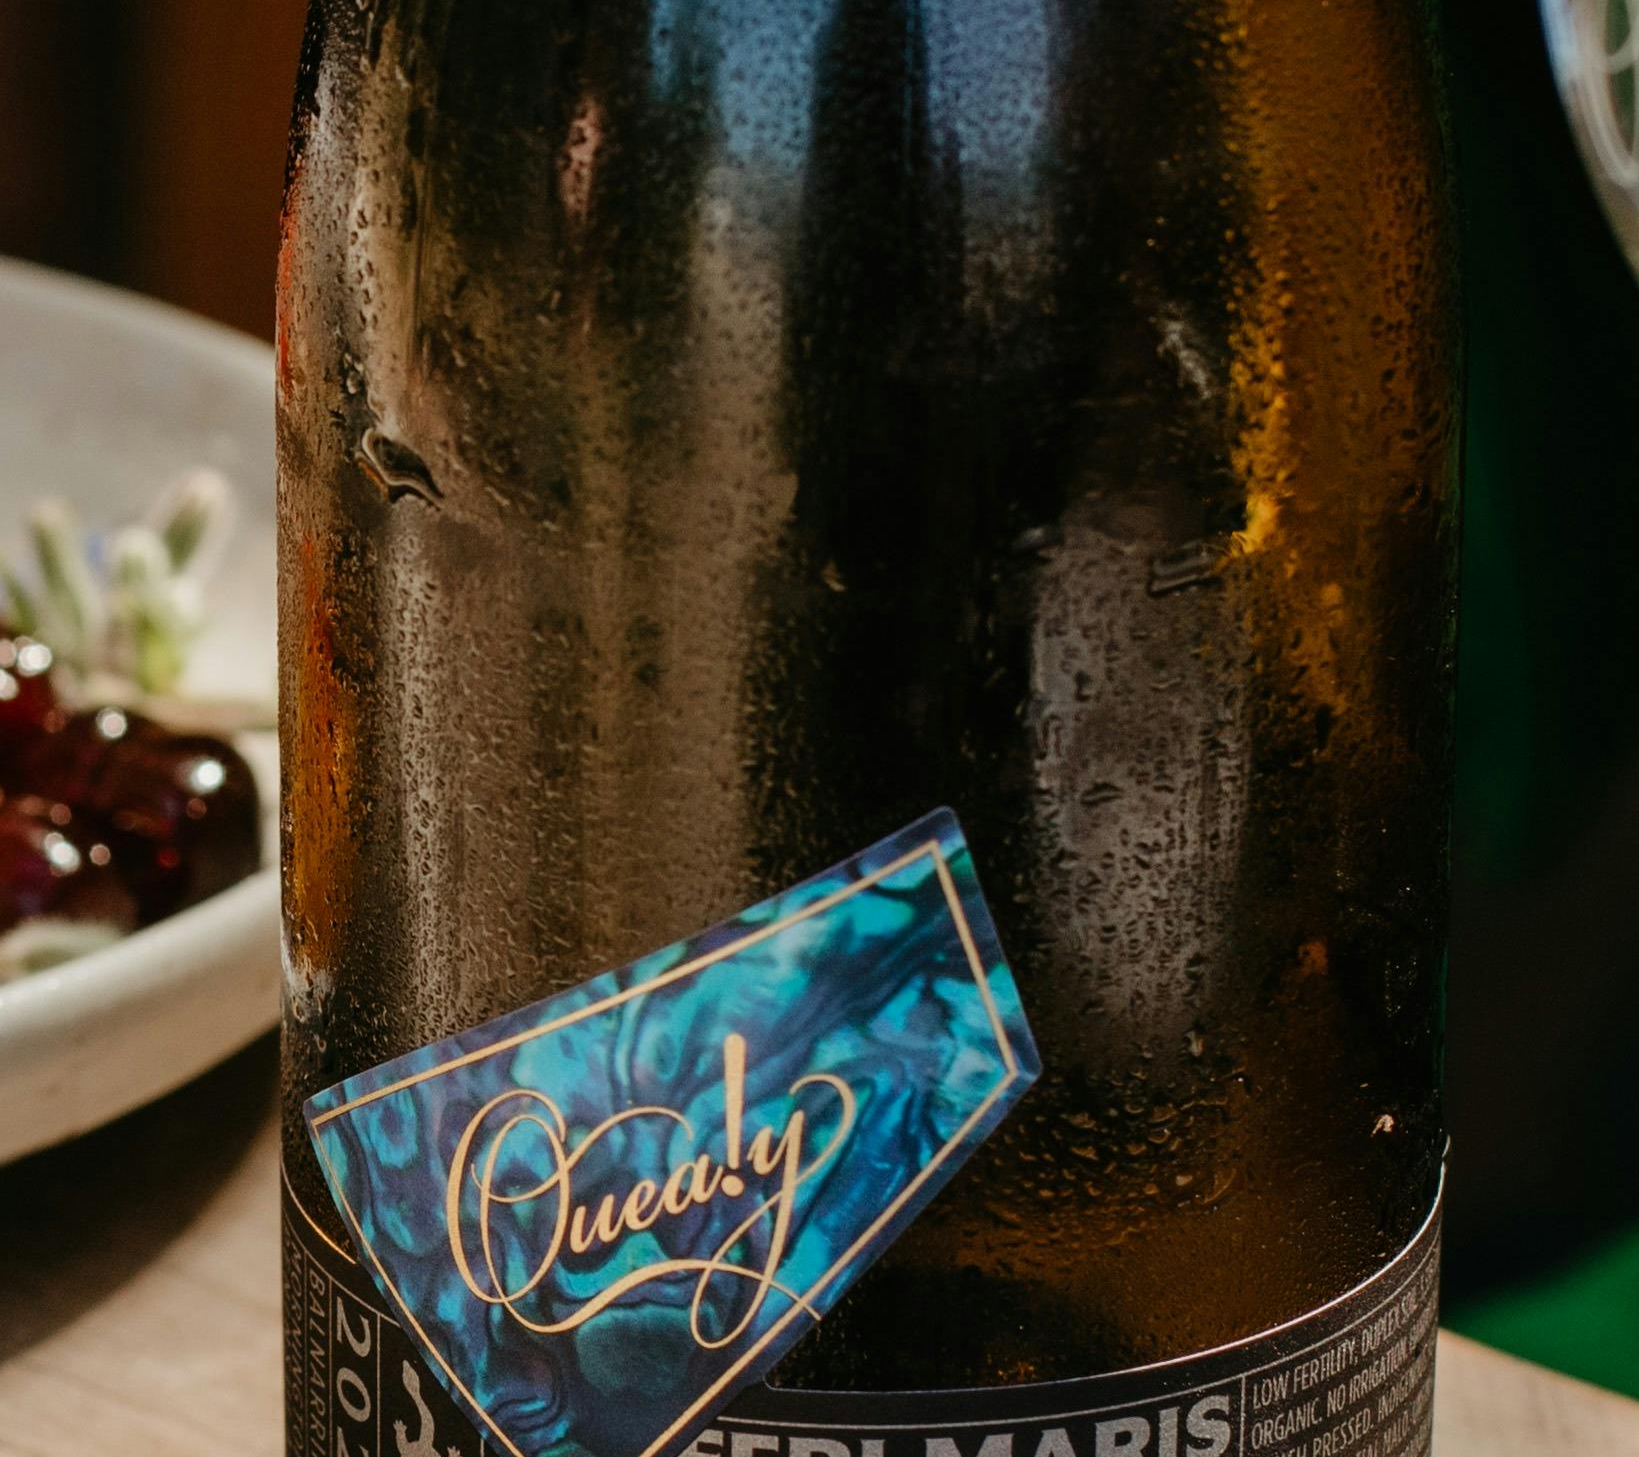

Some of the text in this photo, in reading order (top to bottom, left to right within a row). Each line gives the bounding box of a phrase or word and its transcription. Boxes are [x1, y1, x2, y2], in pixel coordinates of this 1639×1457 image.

[1251, 1397, 1322, 1451] ORGANIC.
[1326, 1383, 1346, 1418] NO
[1253, 1369, 1290, 1411] LOW
